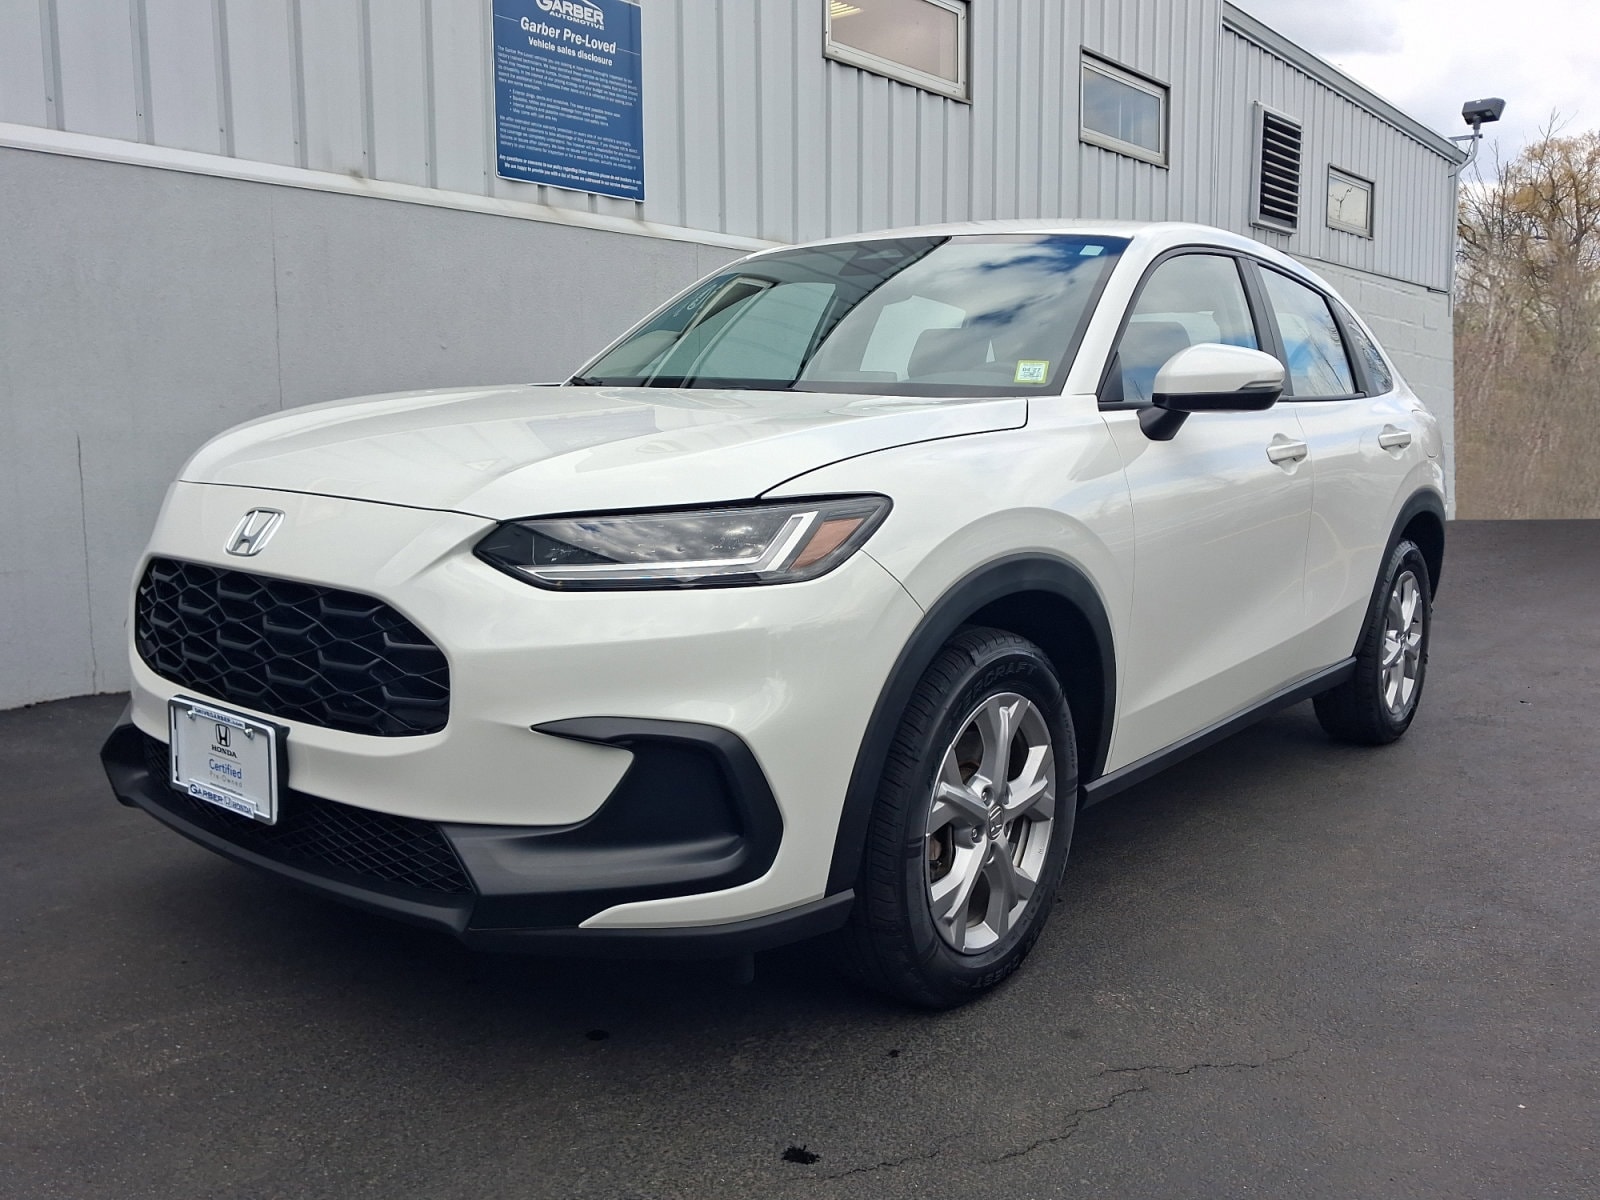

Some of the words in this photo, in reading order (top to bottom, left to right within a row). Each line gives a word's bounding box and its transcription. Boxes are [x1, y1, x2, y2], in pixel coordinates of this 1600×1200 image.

[536, 0, 604, 25] GARBER
[549, 11, 605, 31] AUTOMOTIVE
[520, 16, 560, 39] Garber
[563, 27, 616, 54] Pre-Loved
[528, 36, 556, 52] Vehicle
[556, 45, 576, 57] sales
[577, 50, 613, 66] disclosure
[211, 744, 238, 759] HONDA
[209, 758, 242, 779] Certified
[189, 783, 223, 802] GARBER
